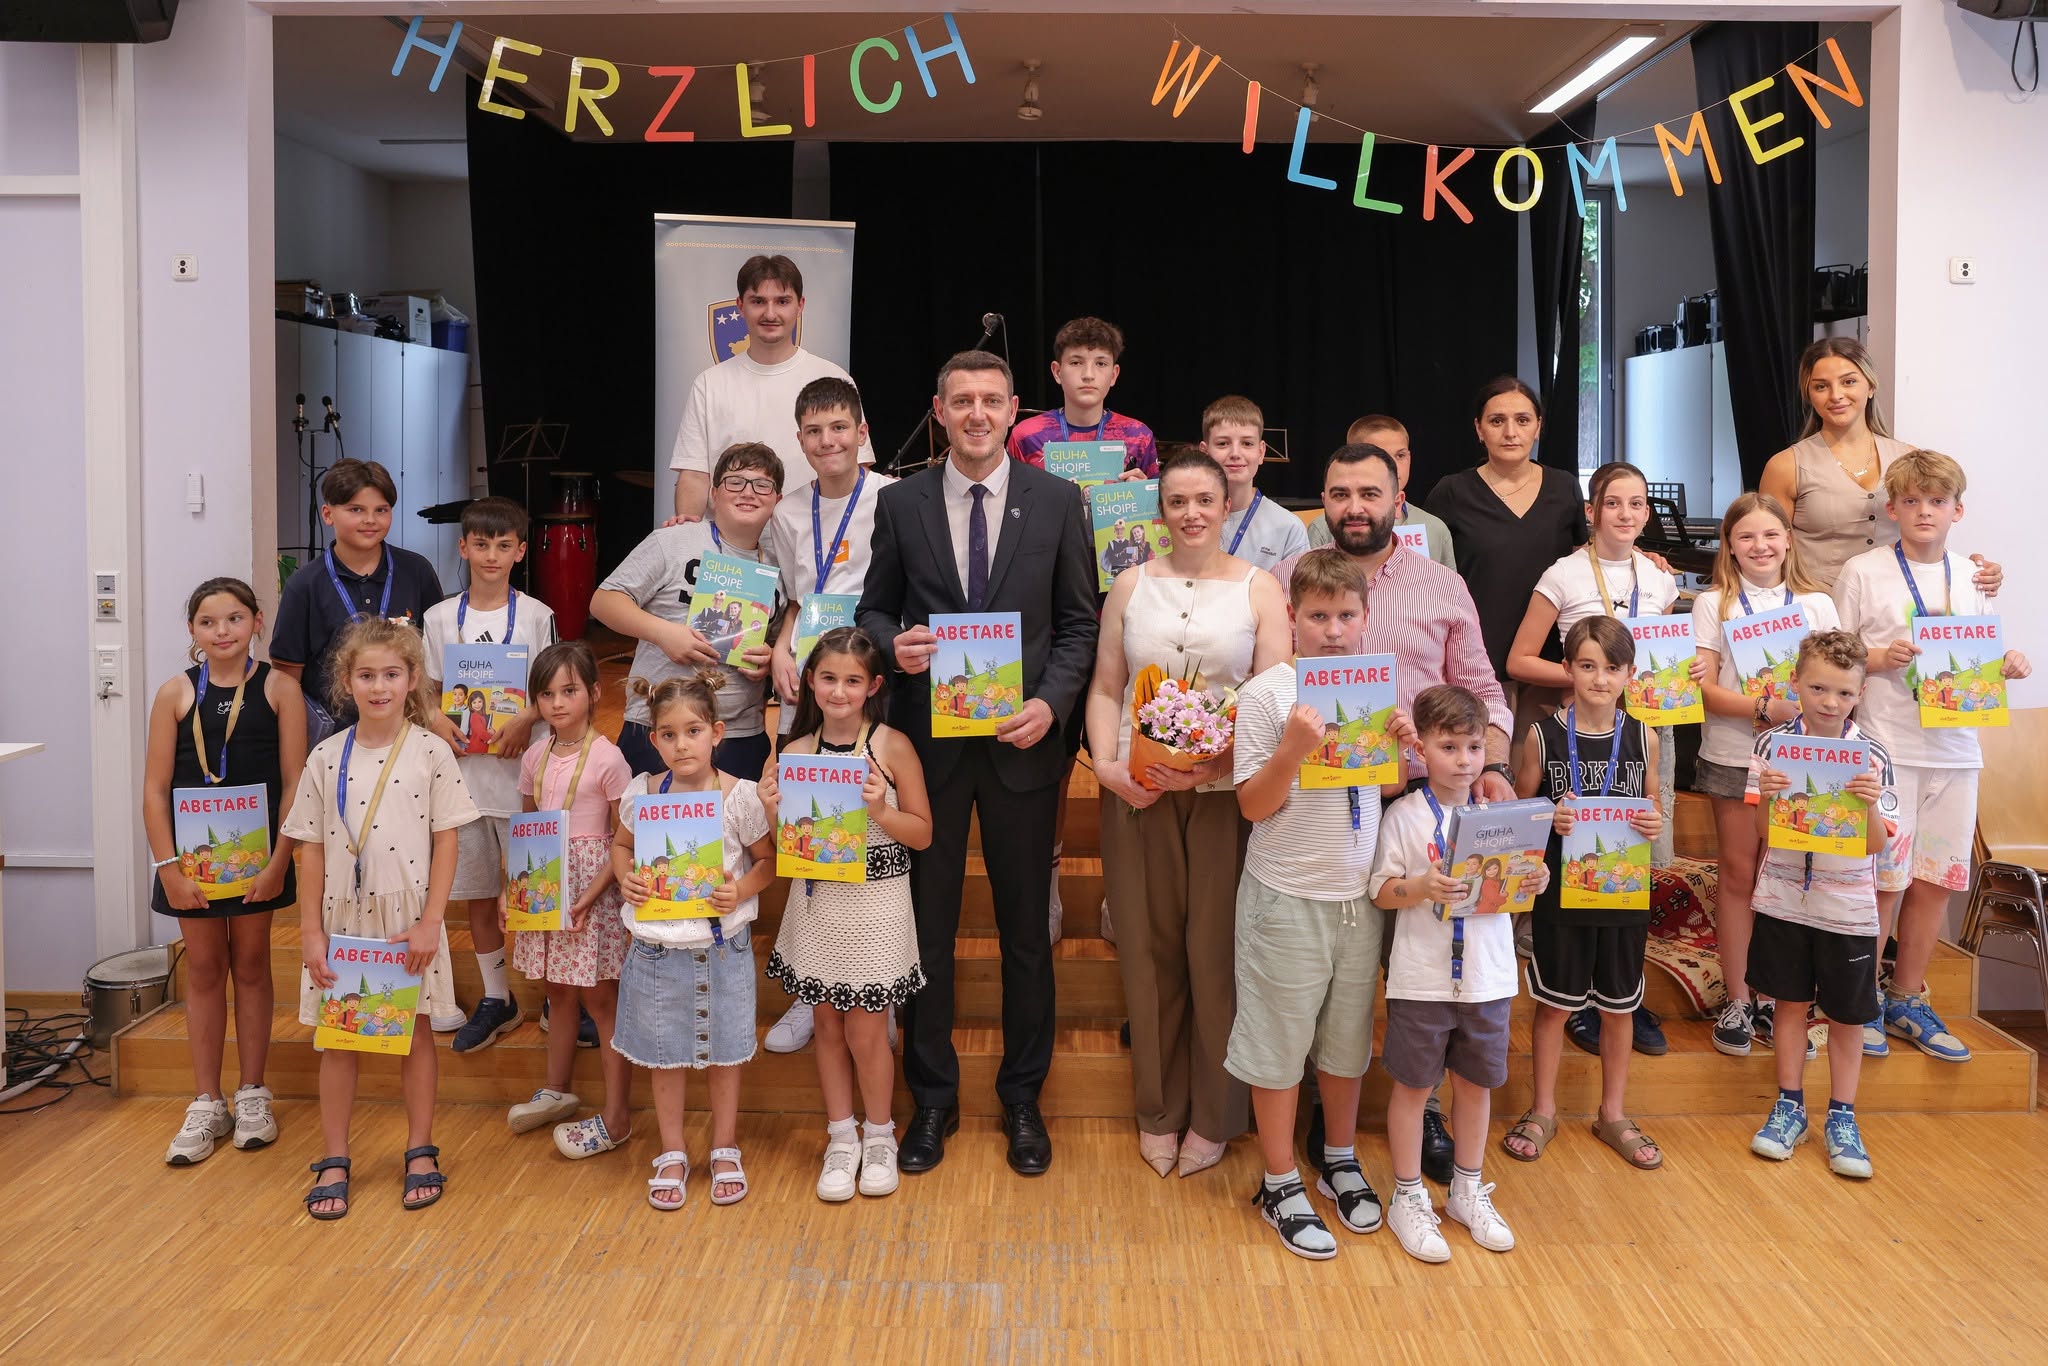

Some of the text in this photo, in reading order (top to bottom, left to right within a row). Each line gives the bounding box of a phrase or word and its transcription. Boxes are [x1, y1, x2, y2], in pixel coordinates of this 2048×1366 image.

[392, 13, 976, 142] HERZLICH
[1151, 37, 1864, 223] WILLKOMMEN
[1050, 450, 1088, 463] GJUHA
[1050, 462, 1091, 473] SHQIPE
[1096, 490, 1135, 506] GJUHA
[1096, 502, 1138, 516] SHQIPE
[705, 559, 743, 577] GJUHA
[702, 571, 743, 589] SHQIPE
[806, 602, 844, 613] GUHA
[935, 623, 1015, 640] ABETARE
[1632, 623, 1690, 641] BETARE
[1732, 613, 1803, 642] ABETARE
[1919, 625, 1997, 640] ABETARE
[458, 660, 493, 671] GJUHA
[457, 669, 494, 681] SHQIPE
[1304, 666, 1391, 687] ABETARE
[1776, 744, 1863, 765] ABETARE
[783, 766, 863, 785] ABETARE
[179, 795, 259, 814] ABETARE
[638, 802, 715, 821] ABETARE
[511, 821, 559, 838] ABETARE
[1475, 826, 1514, 840] GJUHA
[1472, 835, 1515, 849] SHQIPE
[333, 947, 406, 965] ABETAR
